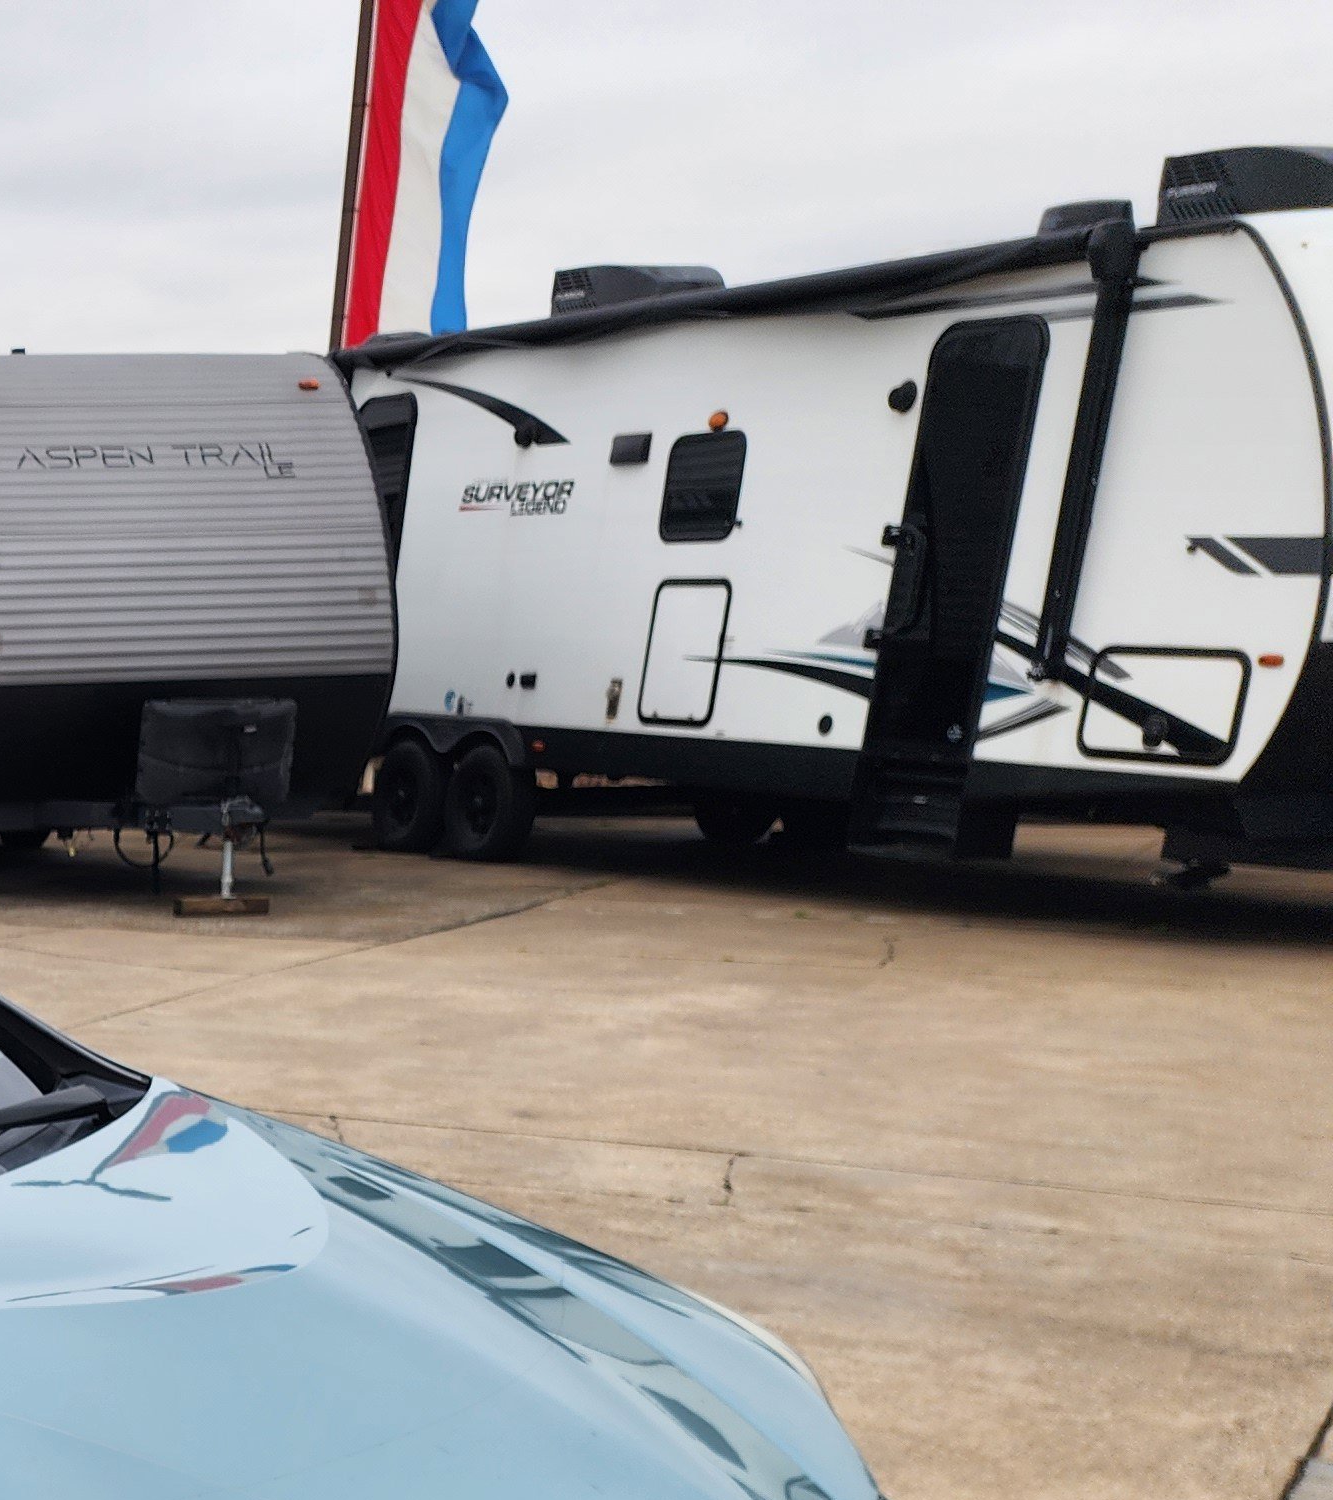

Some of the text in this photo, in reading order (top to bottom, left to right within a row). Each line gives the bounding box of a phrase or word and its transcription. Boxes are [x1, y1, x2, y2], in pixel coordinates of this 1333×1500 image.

[17, 442, 278, 470] ASPEN TRAIL
[461, 479, 575, 504] SURVEYOR
[510, 499, 567, 517] LEGEND
